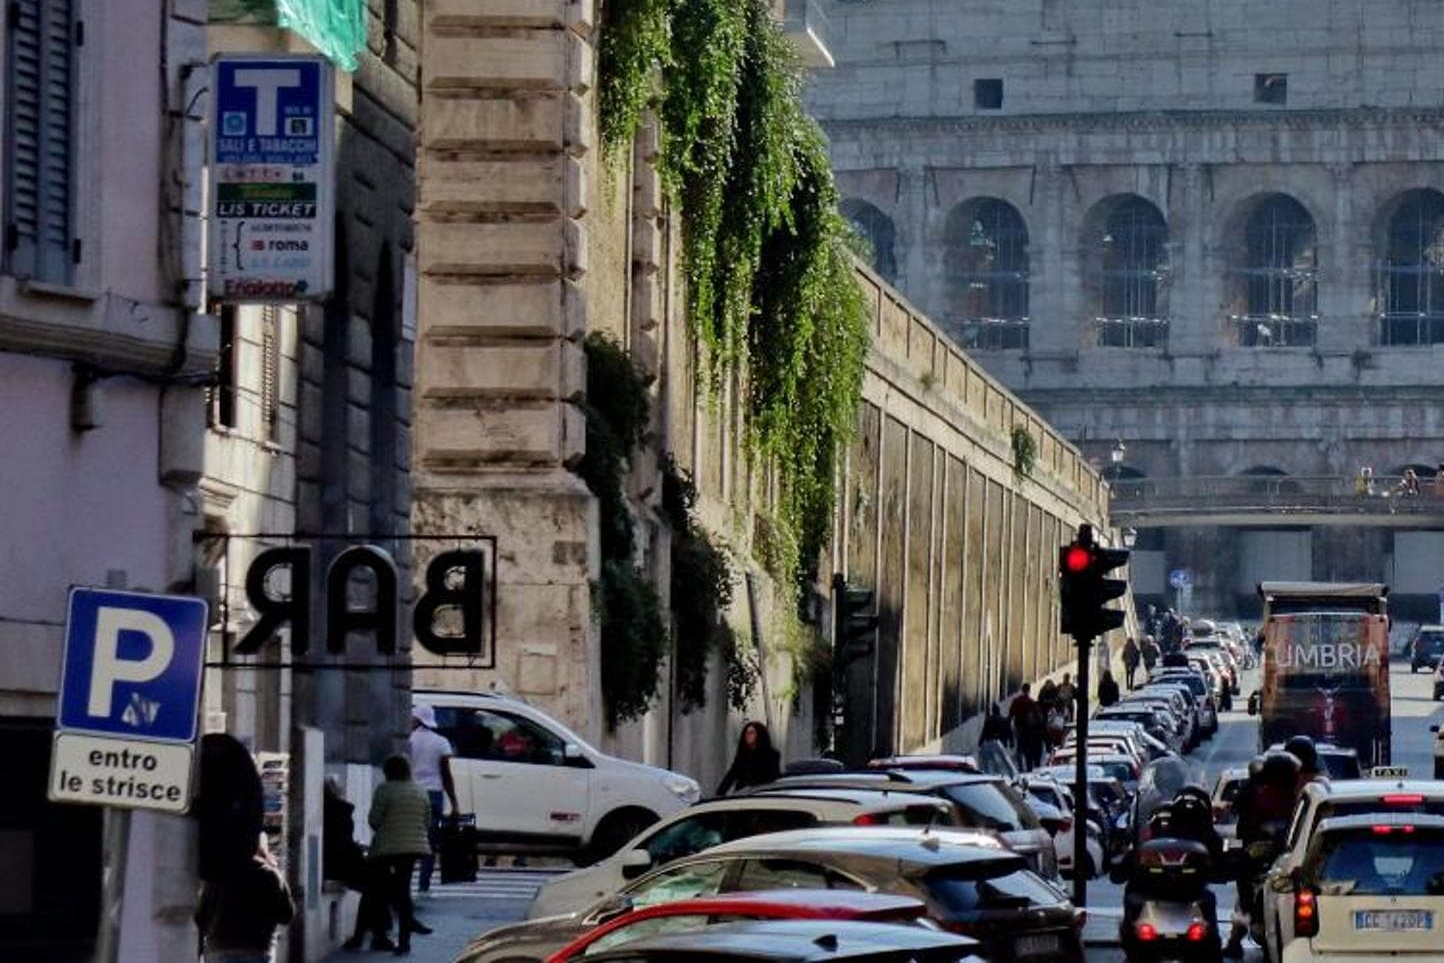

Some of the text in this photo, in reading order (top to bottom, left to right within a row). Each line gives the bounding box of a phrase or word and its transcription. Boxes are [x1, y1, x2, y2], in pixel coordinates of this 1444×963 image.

[234, 69, 301, 135] T
[219, 203, 314, 215] LIS TICKET
[269, 240, 309, 251] roma
[88, 606, 174, 717] P
[1275, 643, 1381, 668] UMBRIA
[89, 748, 157, 772] entro
[60, 770, 181, 802] le strisce
